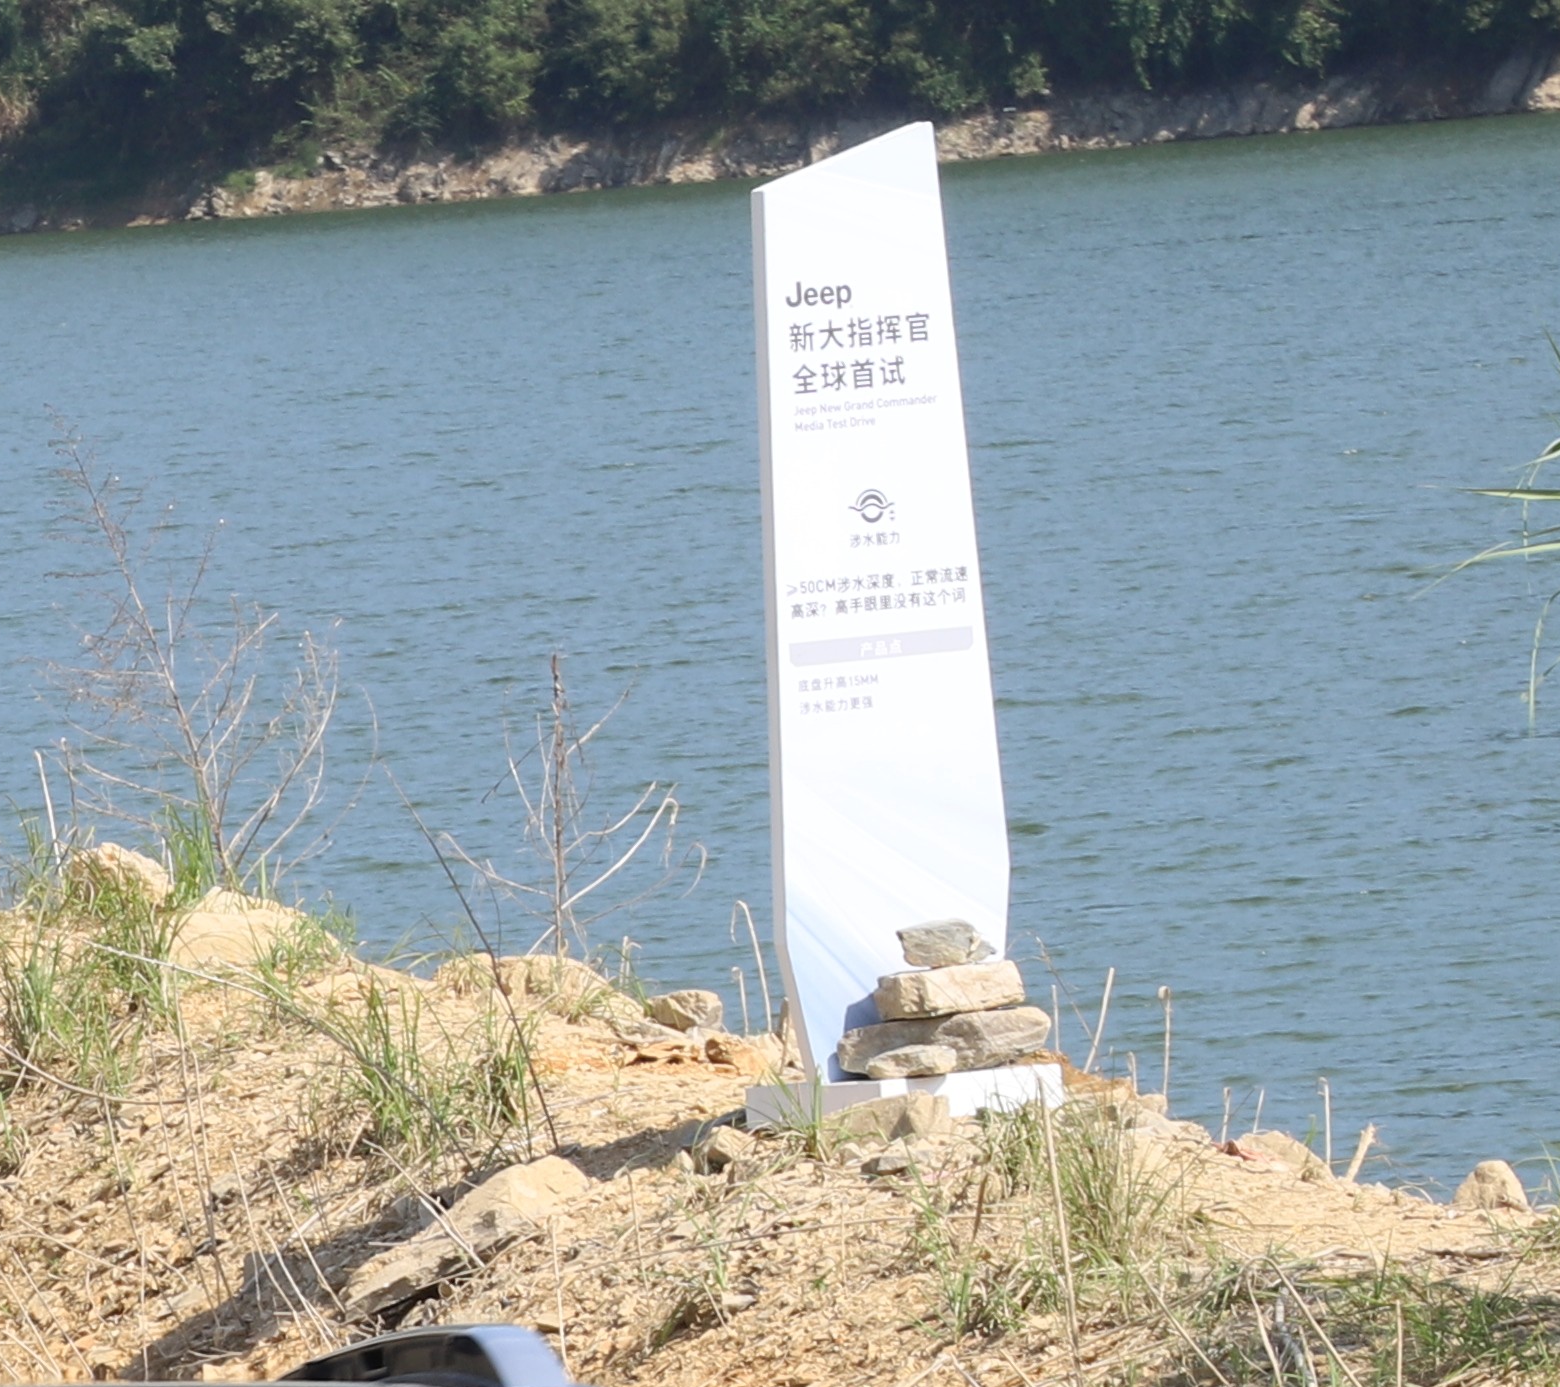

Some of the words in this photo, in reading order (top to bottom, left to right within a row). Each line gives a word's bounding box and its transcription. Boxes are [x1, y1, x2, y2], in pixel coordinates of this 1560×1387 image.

[786, 281, 852, 309] Jeep
[789, 312, 929, 352] 新大指挥官
[792, 355, 906, 395] 全球首试
[794, 405, 818, 417] Jeep
[820, 403, 842, 414] New
[844, 399, 874, 412] Grand
[876, 394, 938, 409] Commander
[794, 420, 825, 432] Media
[827, 418, 847, 429] Test
[849, 416, 876, 428] Drive
[849, 531, 901, 548] 涉水能力
[859, 638, 903, 658] 产品点
[799, 695, 874, 715] 涉水能力更强
